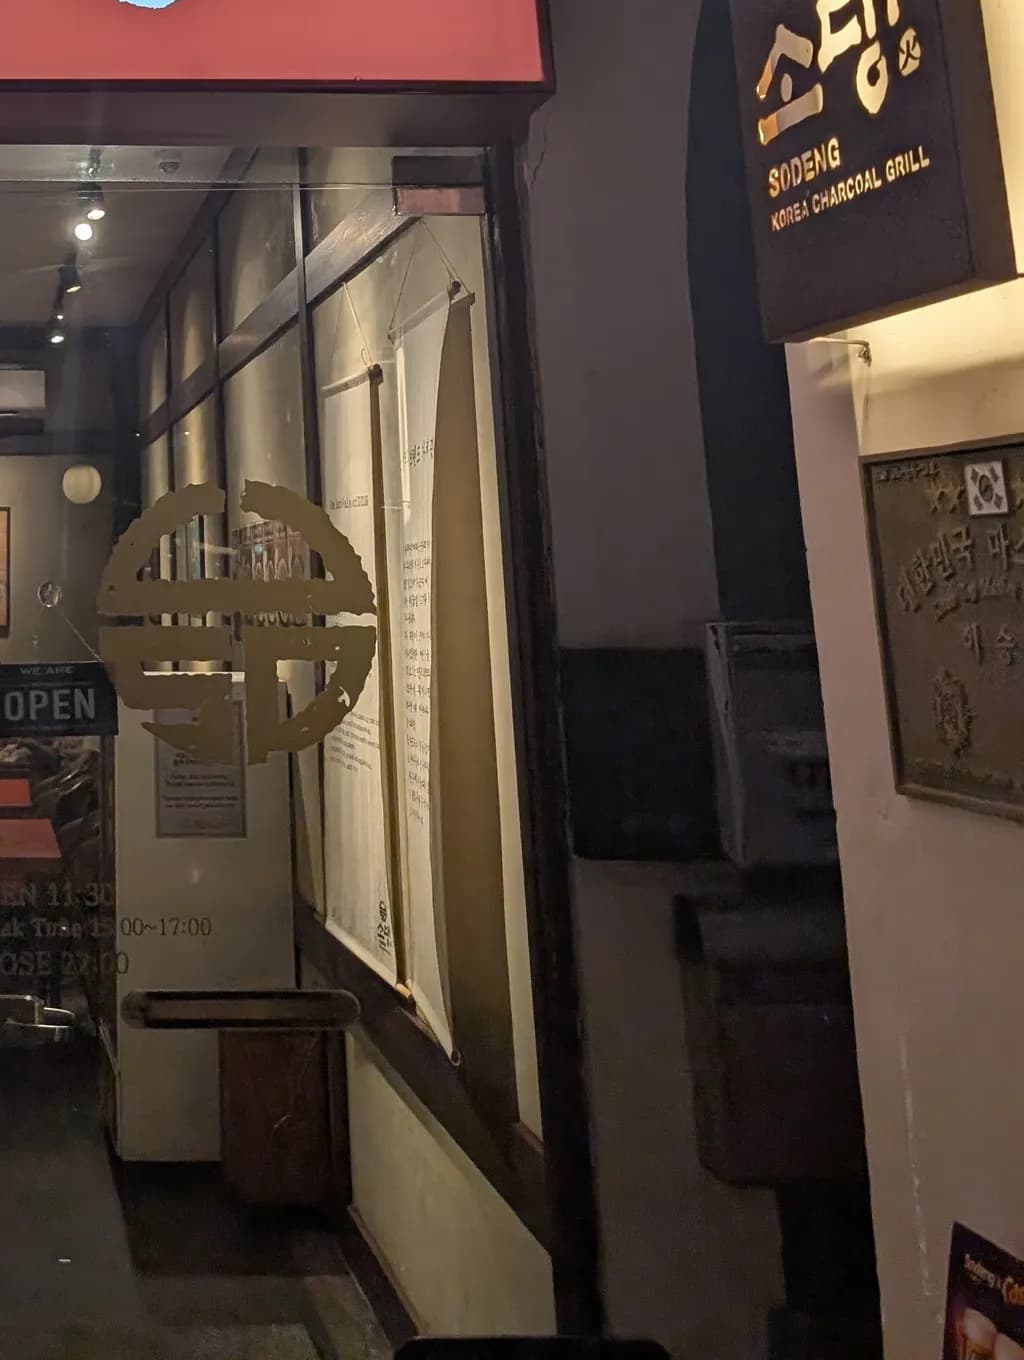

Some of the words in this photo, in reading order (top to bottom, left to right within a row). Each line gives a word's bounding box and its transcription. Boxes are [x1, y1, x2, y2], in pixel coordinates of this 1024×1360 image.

[768, 137, 842, 198] SODENG
[770, 193, 810, 232] KOREA
[812, 167, 882, 216] CHARCOAL
[885, 144, 931, 183] GRILL
[4, 688, 95, 721] OPEN
